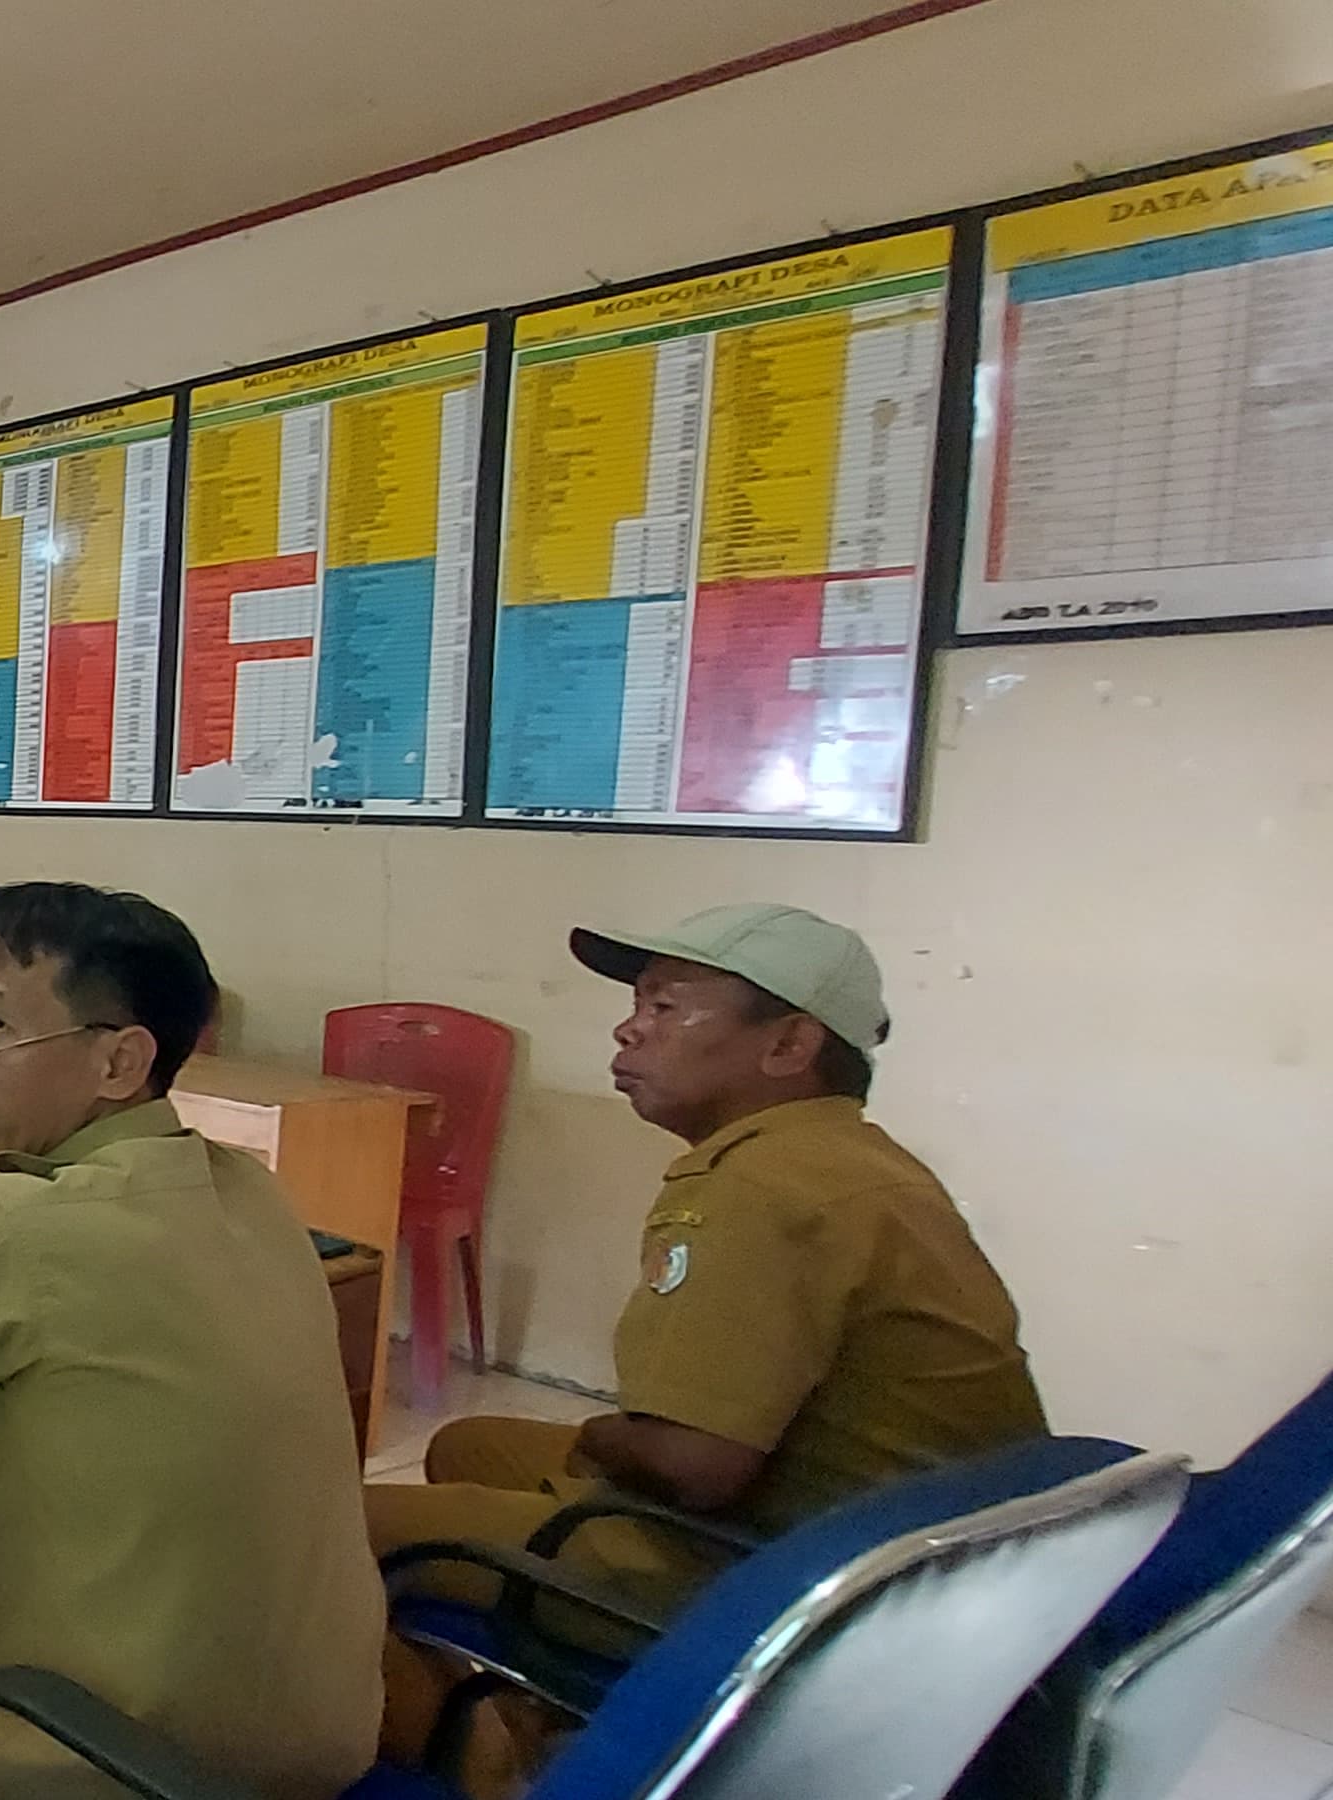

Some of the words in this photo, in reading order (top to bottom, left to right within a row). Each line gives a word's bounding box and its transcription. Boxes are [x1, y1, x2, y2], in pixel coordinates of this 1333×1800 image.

[1107, 187, 1212, 223] DATA
[592, 272, 763, 318] MONOGRAFI
[770, 254, 850, 282] DESA
[242, 353, 359, 390] MONOGRAFI
[364, 339, 418, 361] DESA
